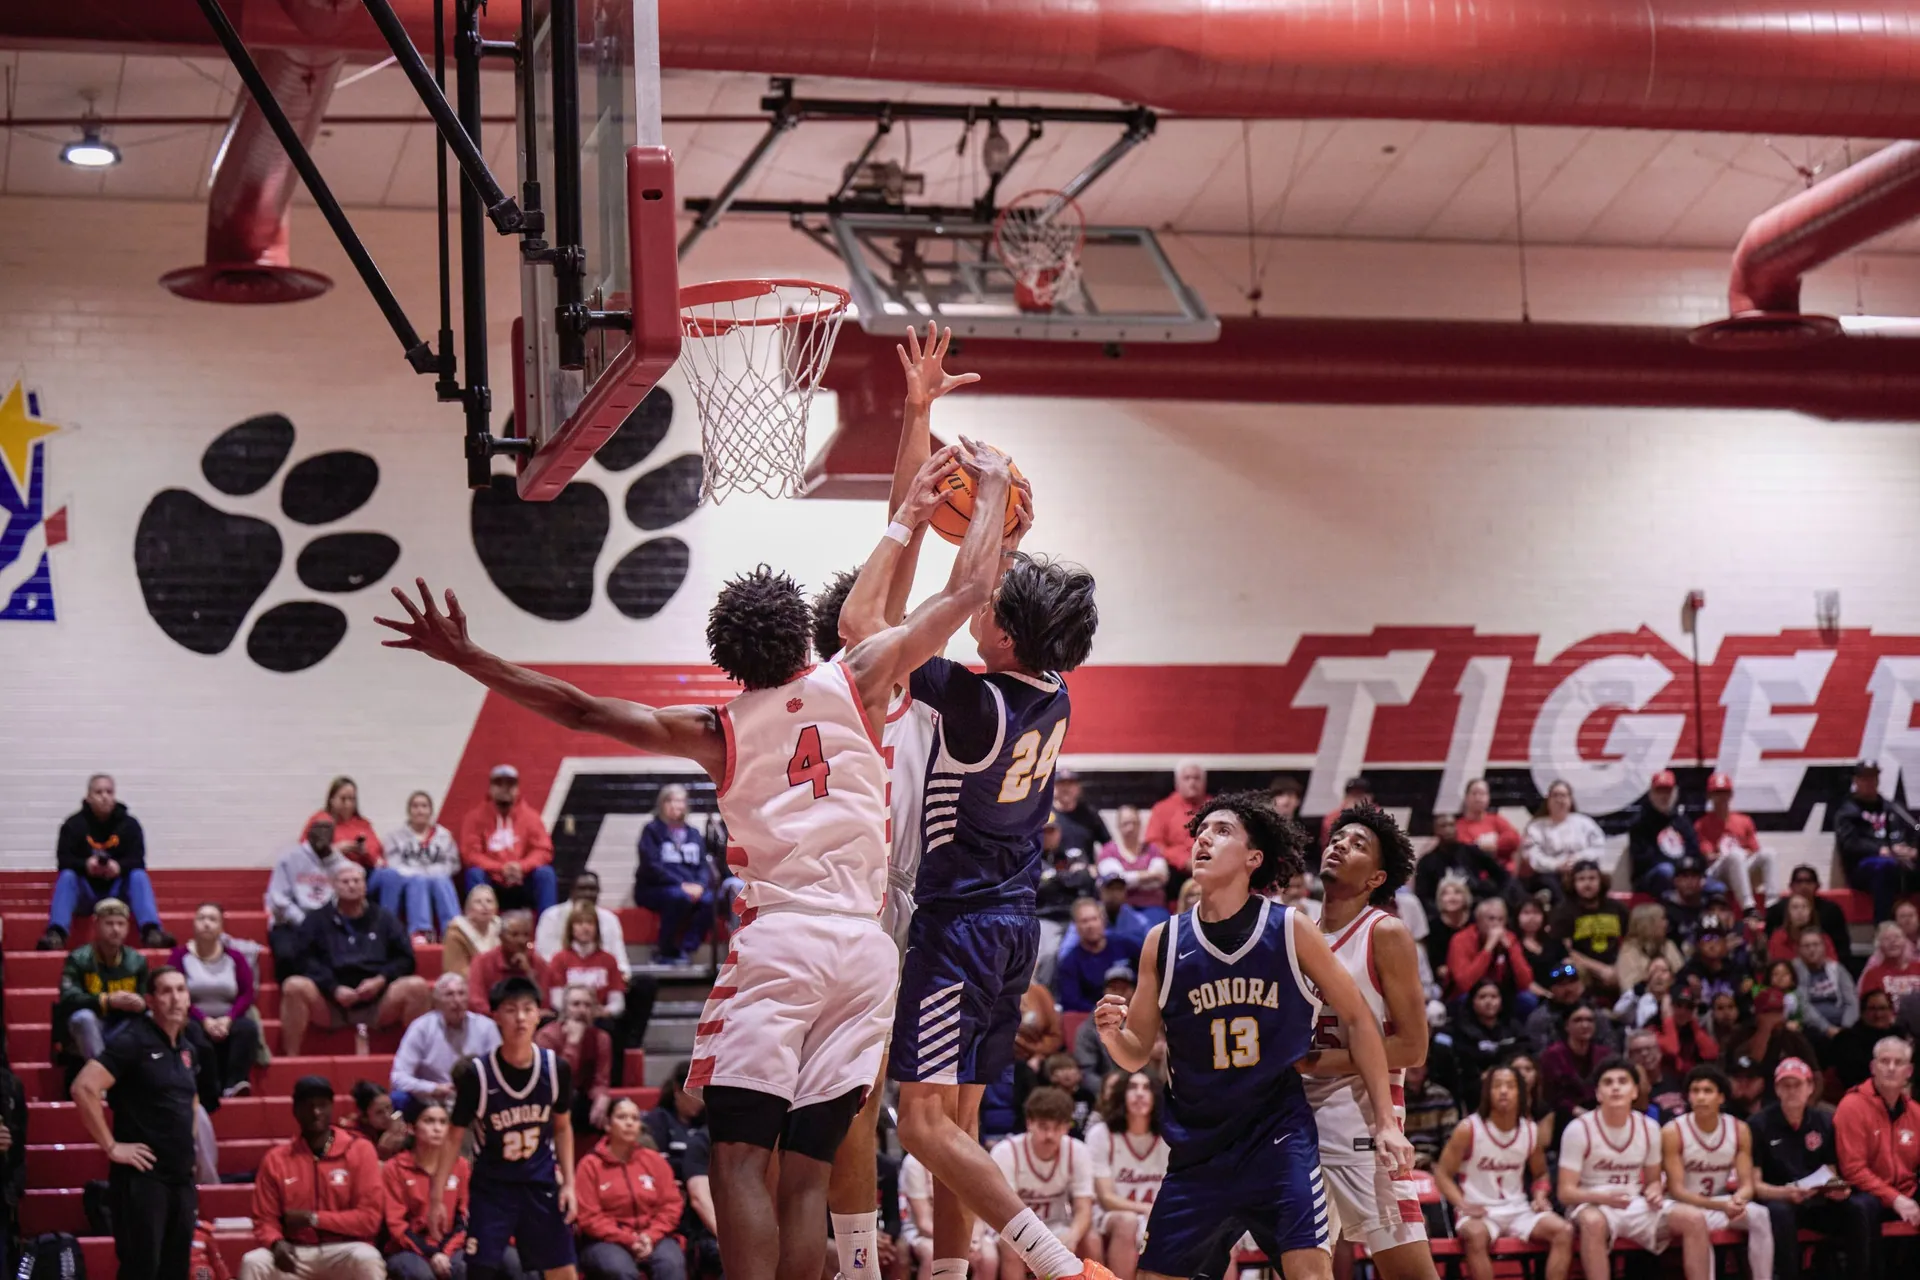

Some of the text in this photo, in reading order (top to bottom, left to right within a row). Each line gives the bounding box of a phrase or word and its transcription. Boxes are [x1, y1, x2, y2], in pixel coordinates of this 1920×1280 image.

[786, 724, 830, 799] 4
[997, 717, 1067, 803] 24
[1188, 977, 1279, 1015] SONORA
[1211, 1016, 1260, 1069] 13
[503, 1127, 540, 1162] 25
[1699, 1176, 1715, 1198] 3
